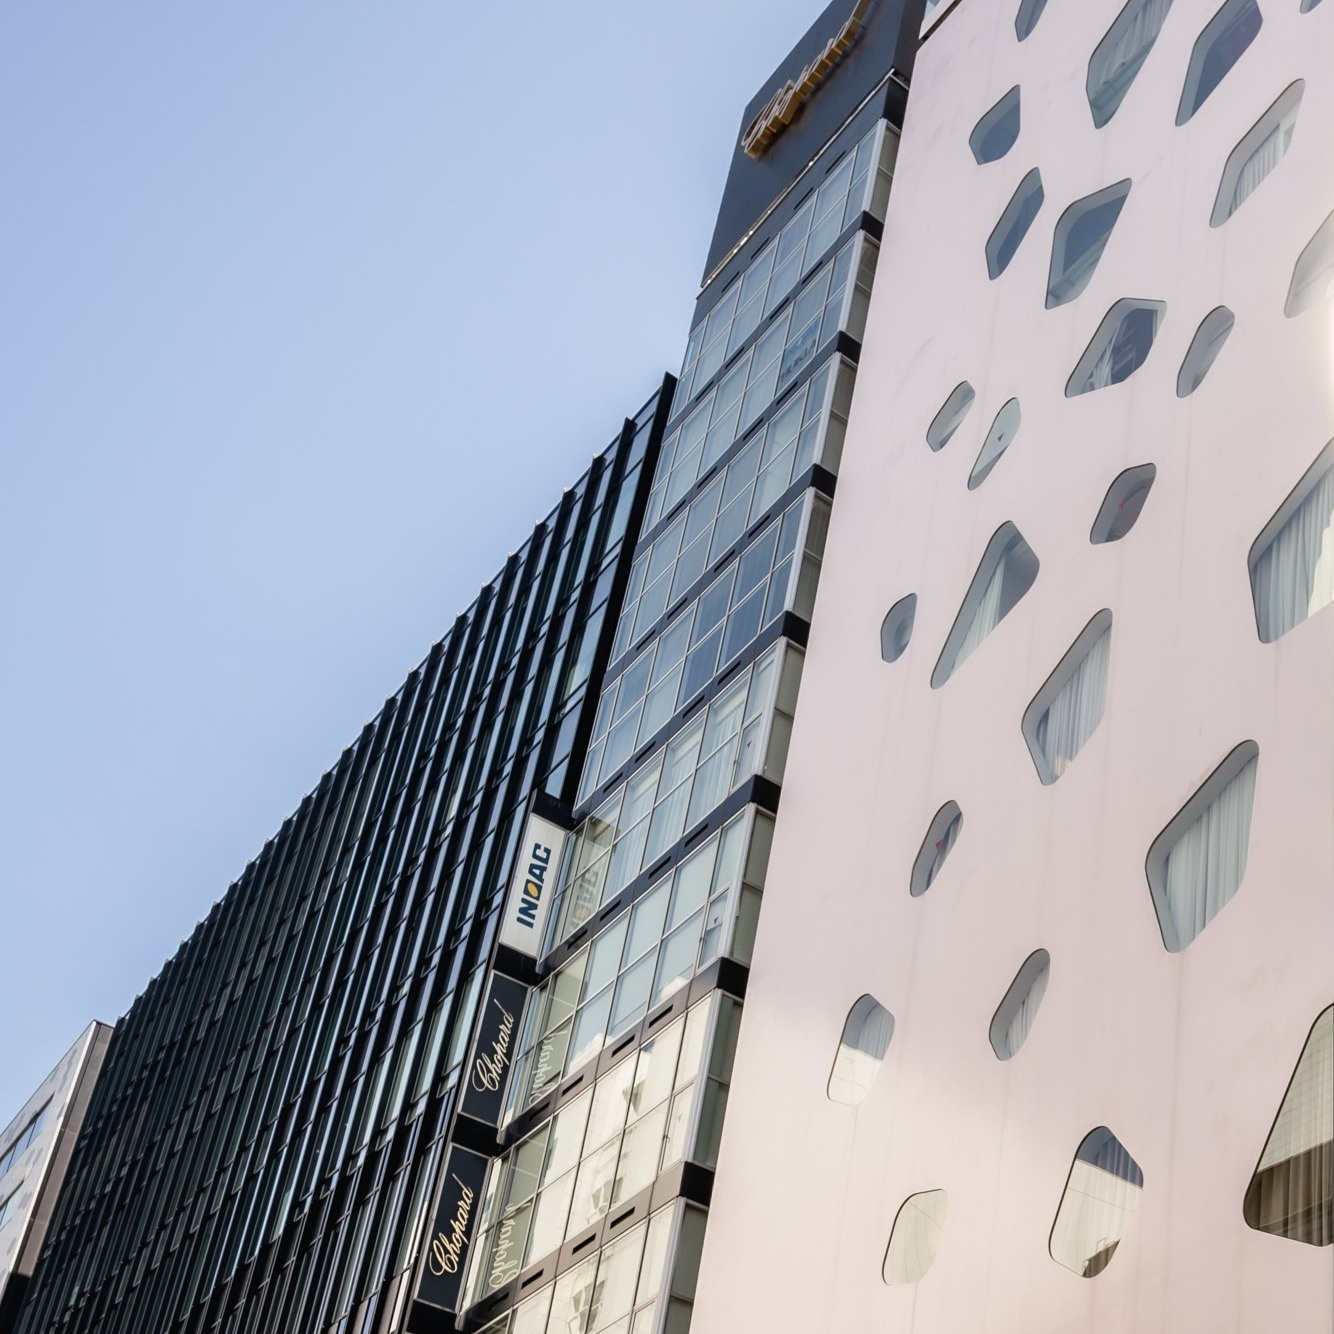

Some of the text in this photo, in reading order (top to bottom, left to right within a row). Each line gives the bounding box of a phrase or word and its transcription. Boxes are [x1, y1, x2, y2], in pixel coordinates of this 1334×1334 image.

[515, 842, 552, 930] INOAC
[472, 998, 515, 1093] Chopard
[429, 1172, 474, 1277] Chopard
